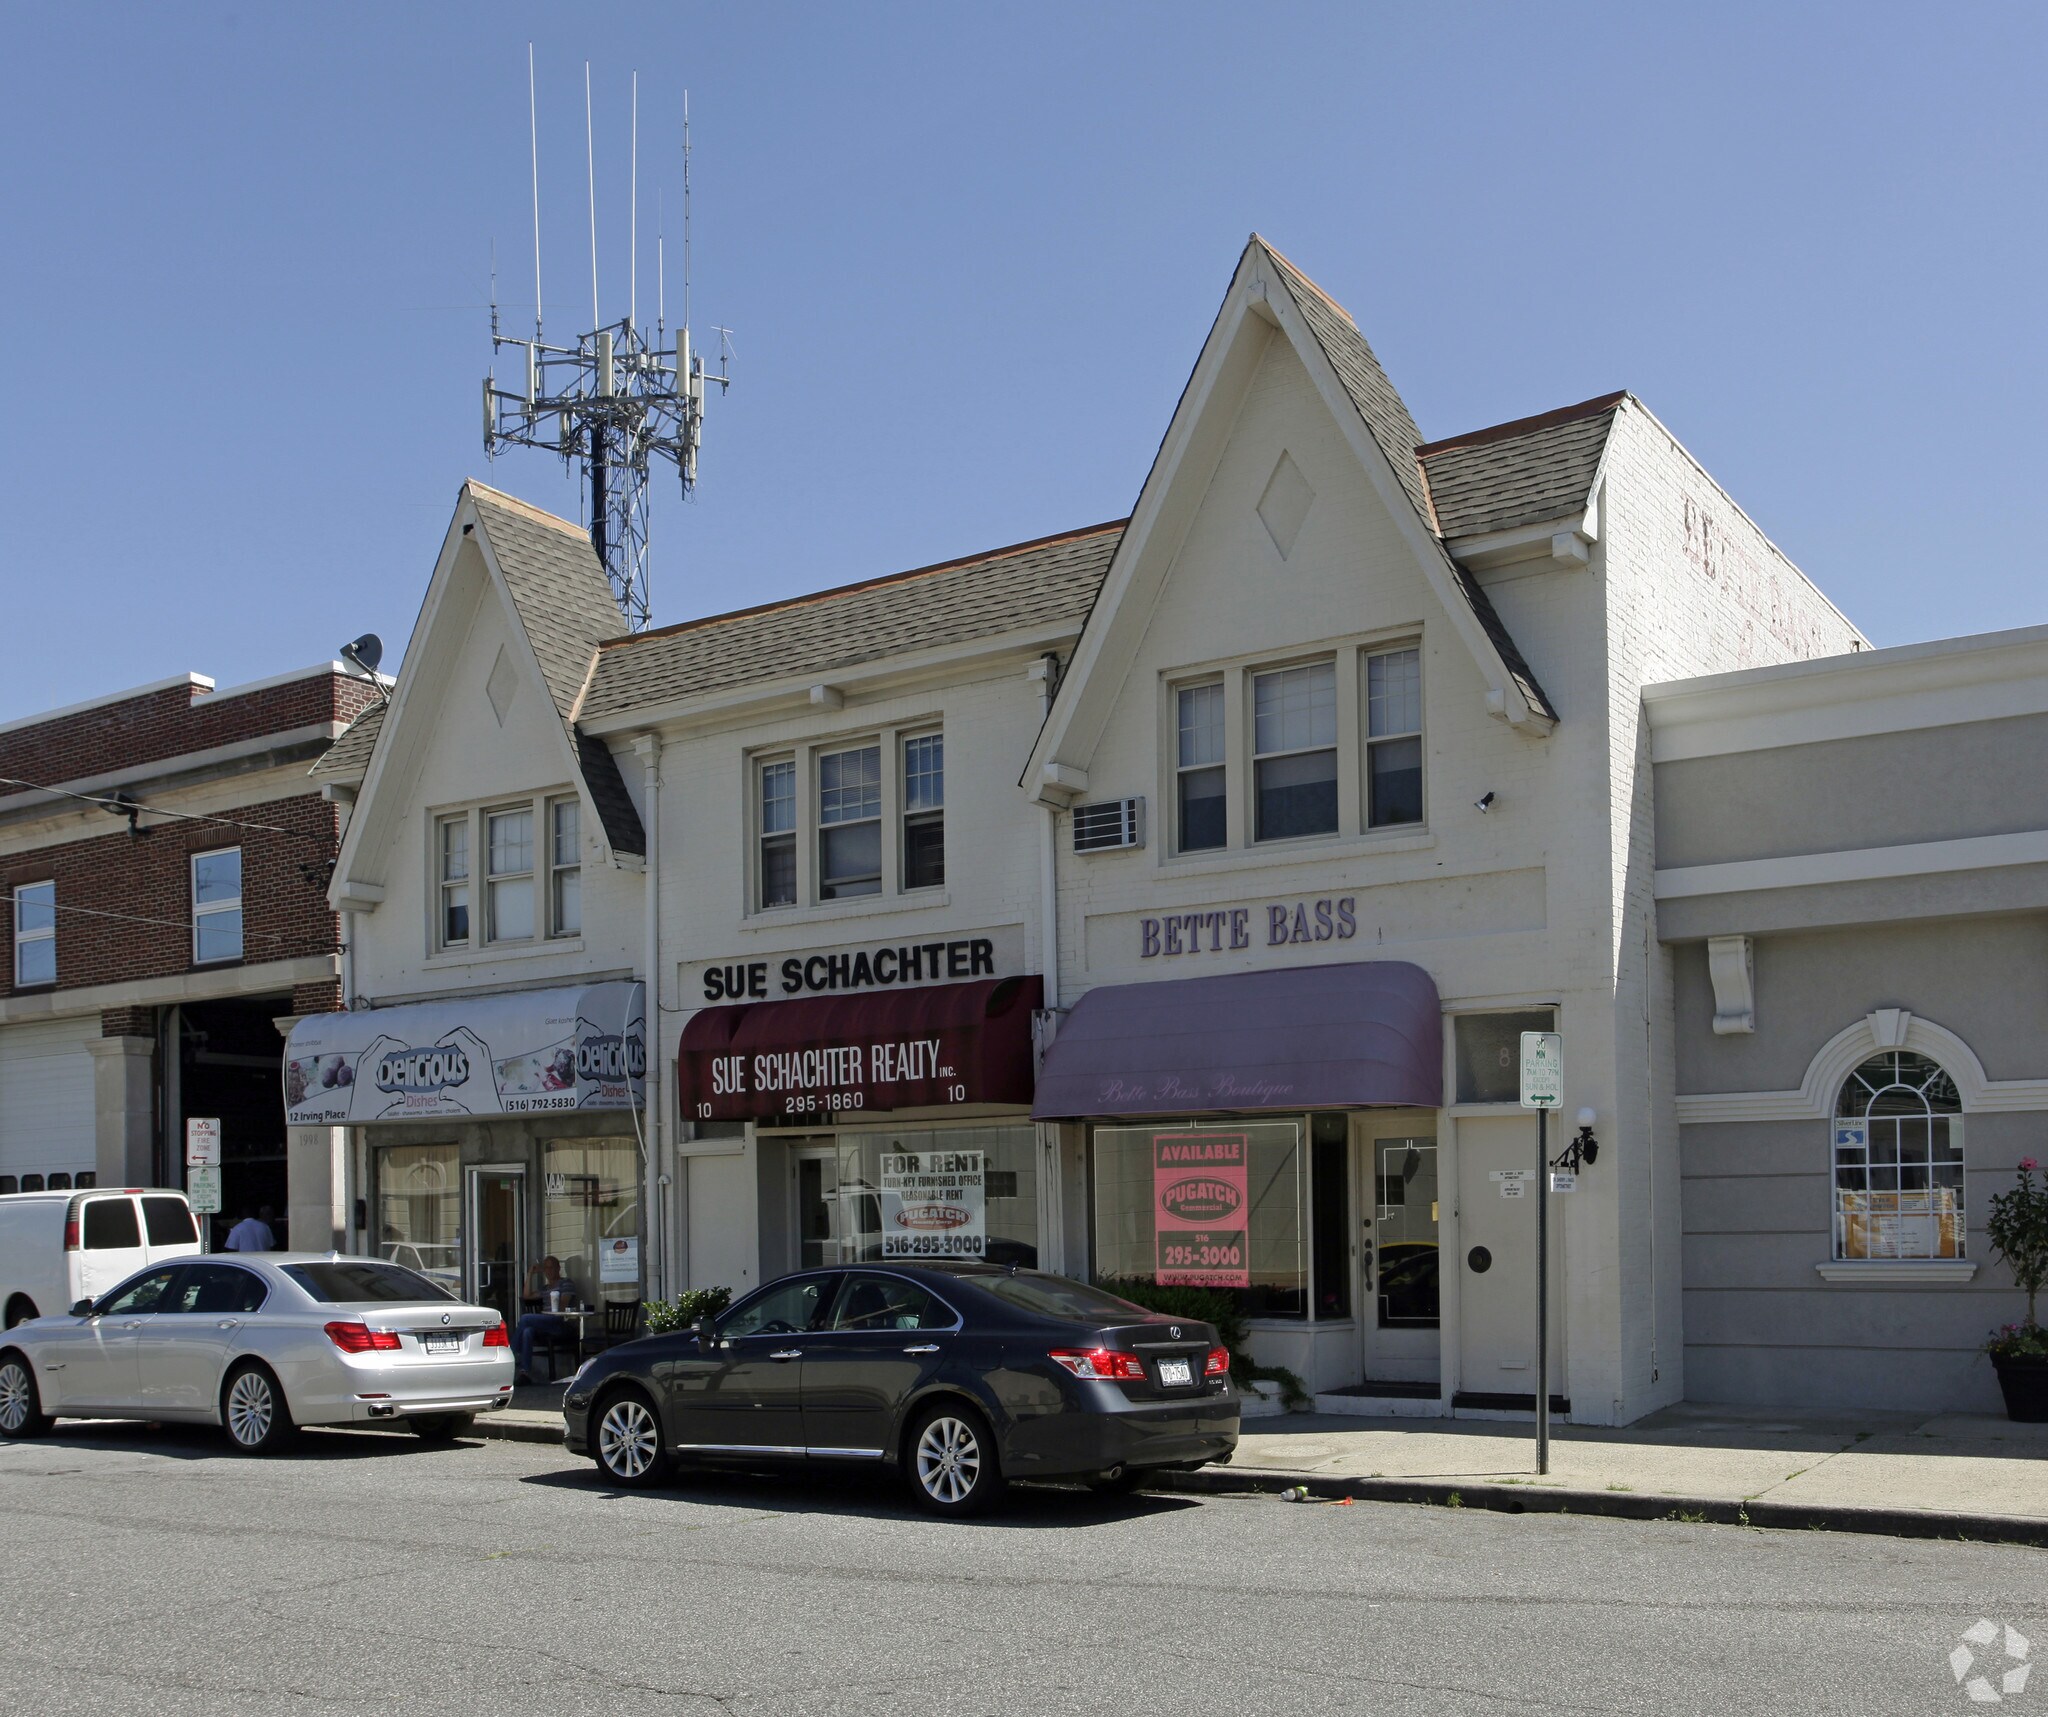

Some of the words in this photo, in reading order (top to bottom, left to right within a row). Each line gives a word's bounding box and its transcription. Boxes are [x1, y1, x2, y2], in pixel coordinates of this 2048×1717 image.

[1140, 909, 1249, 959] BETTE
[1267, 897, 1357, 946] BASS
[703, 963, 768, 1000] SUE
[781, 938, 995, 994] SCHACHTER
[1536, 1040, 1546, 1050] 90
[1500, 1047, 1510, 1067] 8
[1536, 1050, 1546, 1059] MIN
[712, 1056, 746, 1095] SUE
[755, 1045, 863, 1091] SCHACHTER
[872, 1039, 940, 1083] REALTY
[940, 1066, 957, 1078] INC.
[1526, 1059, 1558, 1068] PARKING
[1526, 1068, 1537, 1076] 7AM
[1548, 1068, 1559, 1076] 7PM
[602, 1085, 626, 1098] Dishes
[948, 1085, 965, 1101] 10
[1098, 1079, 1147, 1103] Bette
[1153, 1076, 1199, 1100] Bass
[1208, 1074, 1294, 1103] Boutique
[1526, 1083, 1538, 1091] SUN
[1540, 1083, 1544, 1091] &
[1545, 1083, 1558, 1091] HOL
[406, 1095, 438, 1108] Dishes
[505, 1099, 529, 1112] (516)
[532, 1097, 576, 1110] 792-5830
[786, 1091, 863, 1113] 295-1860
[289, 1112, 299, 1122] 12
[300, 1111, 323, 1123] Irving
[325, 1109, 346, 1120] Place
[696, 1102, 712, 1119] 10
[299, 1134, 319, 1146] 1998
[1161, 1144, 1240, 1161] AVAILABLE
[883, 1155, 920, 1174] FOR
[929, 1153, 981, 1173] RENT
[883, 1176, 916, 1188] TURN-KEY
[918, 1175, 956, 1187] FURNISHED
[959, 1175, 982, 1186] OFFICE
[901, 1190, 944, 1201] REASONABLE
[946, 1189, 963, 1200] RENT
[1166, 1183, 1237, 1208] PUGATCH
[900, 1208, 966, 1222] PUGATCH
[885, 1235, 982, 1254] 516-295-3000
[1195, 1234, 1210, 1242] 516
[1165, 1246, 1241, 1265] 295-3000
[1164, 1273, 1242, 1281] WWW.PUGATCH.COM
